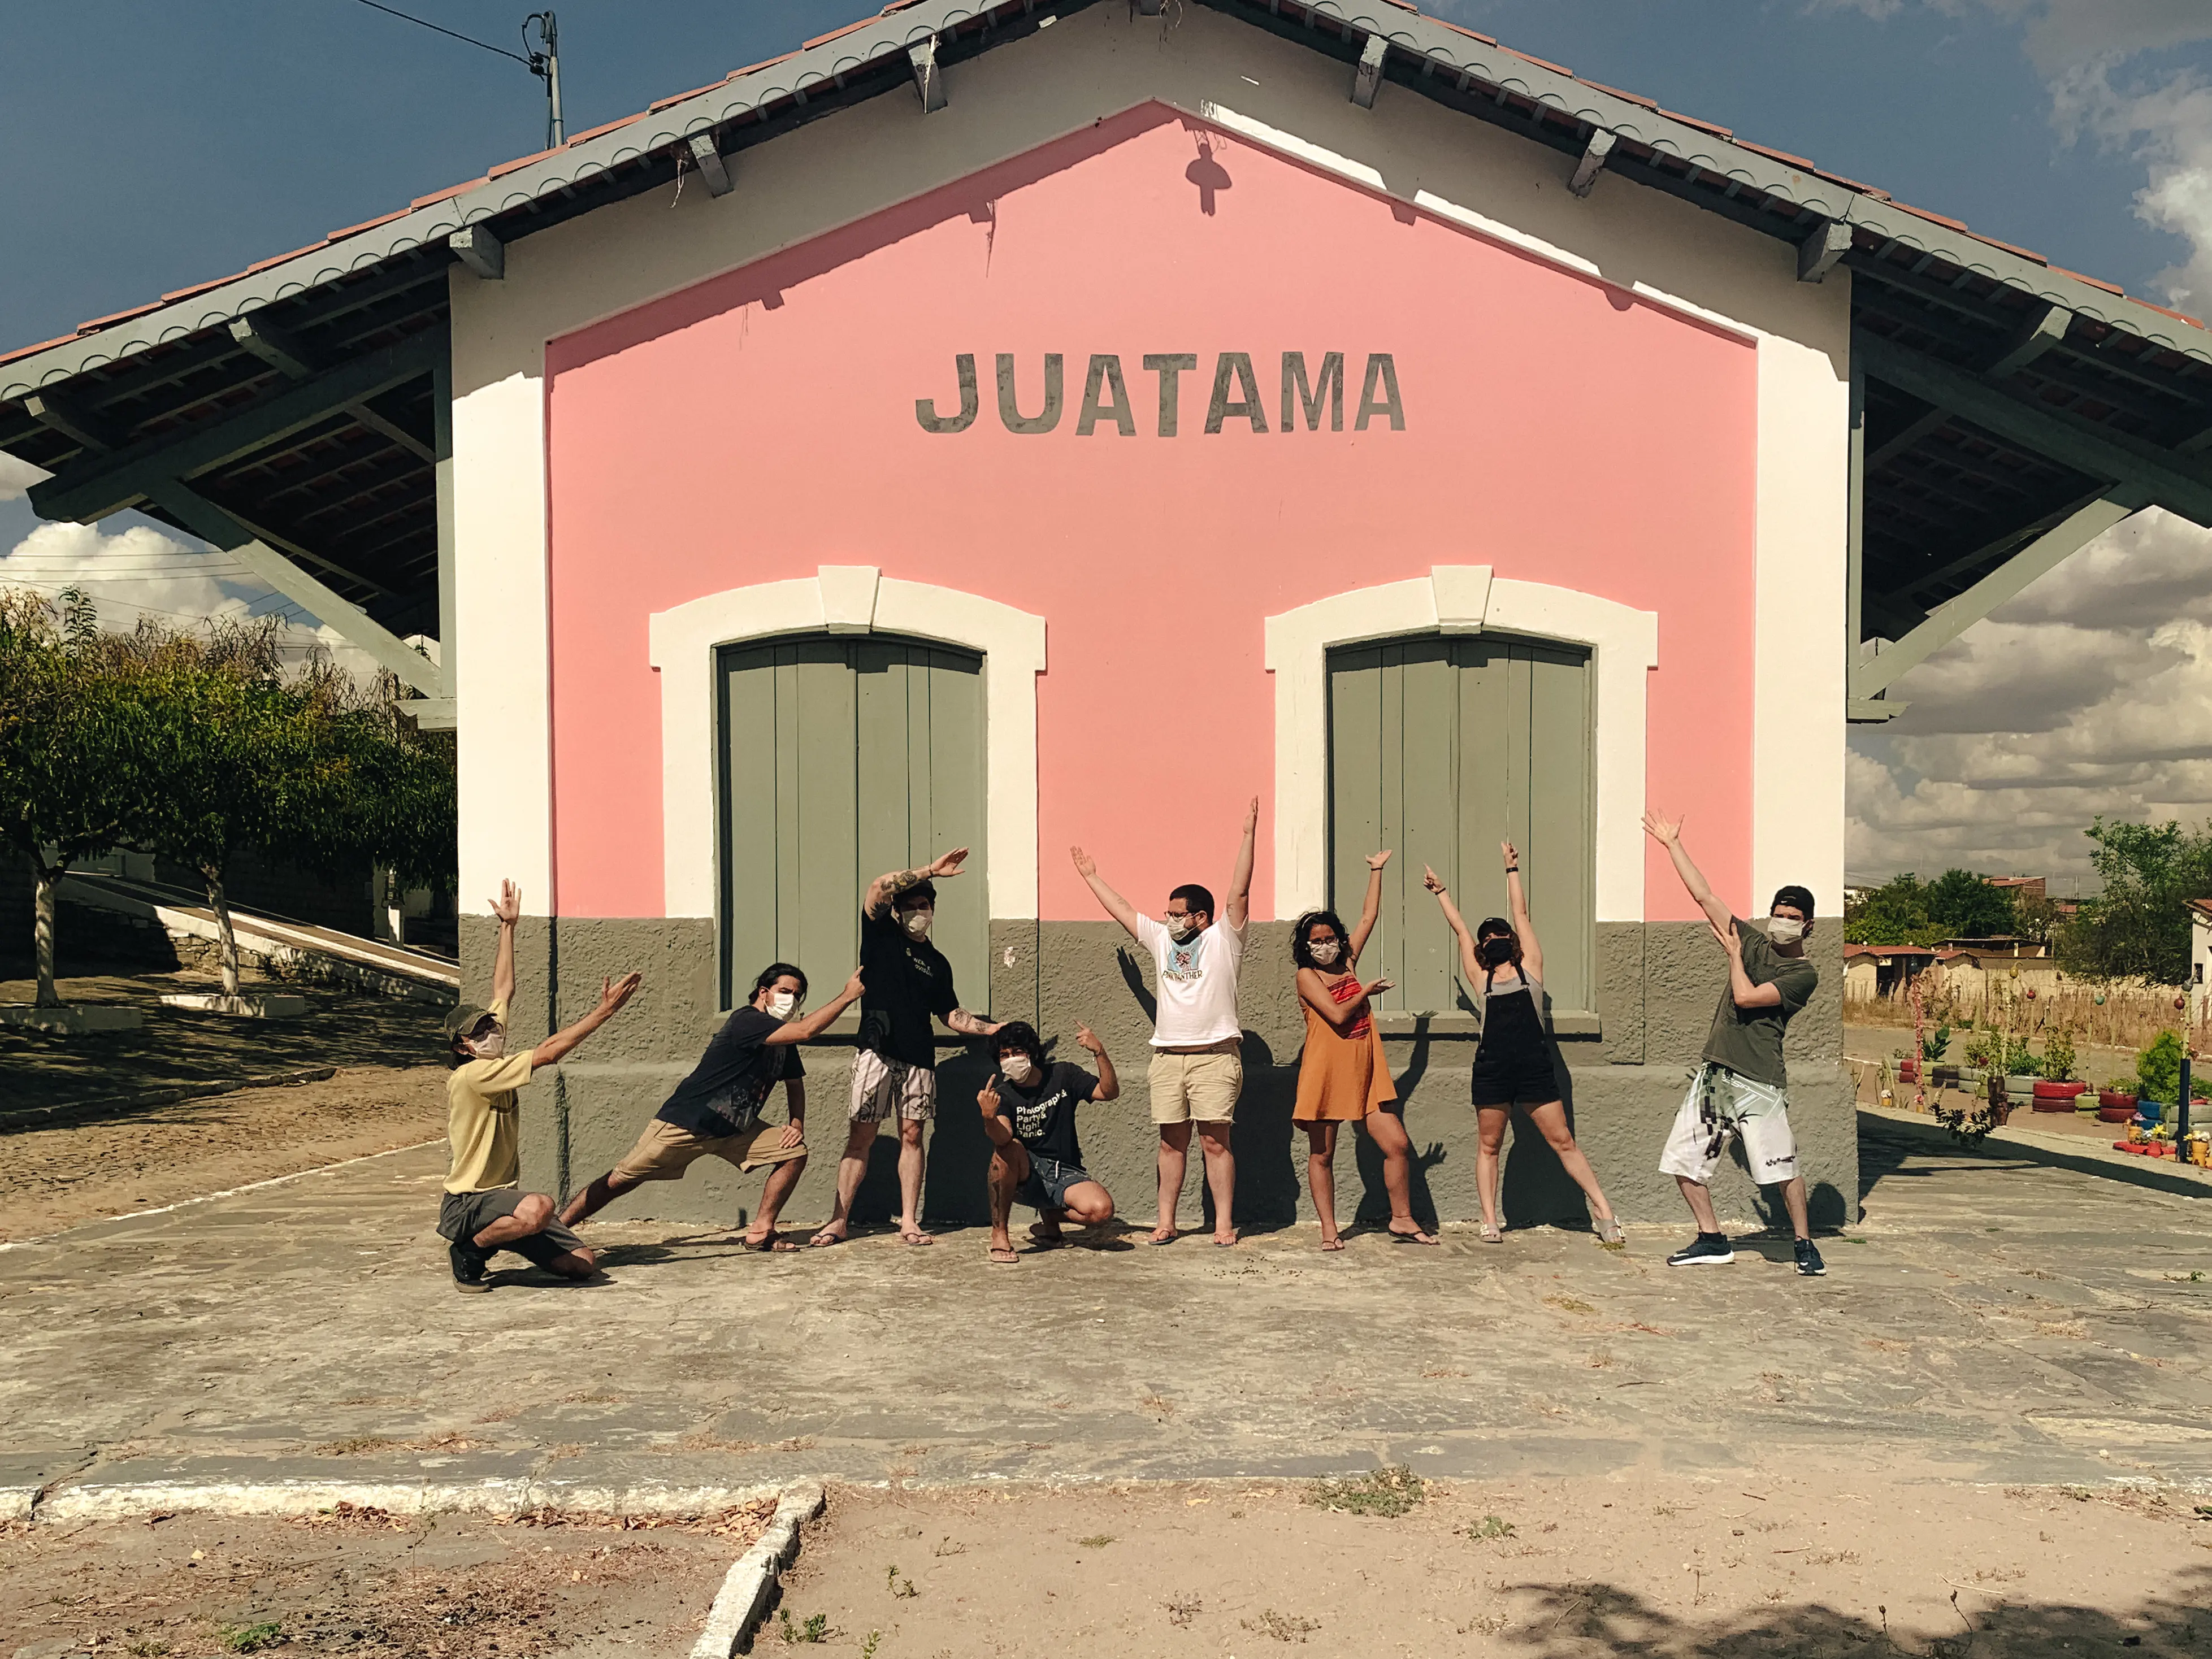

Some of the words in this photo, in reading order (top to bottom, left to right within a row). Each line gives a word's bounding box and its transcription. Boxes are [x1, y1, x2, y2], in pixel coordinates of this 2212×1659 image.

[916, 351, 1406, 437] JUATAMA
[1174, 970, 1203, 981] PANTHER
[1017, 1114, 1040, 1123] Party
[1040, 1111, 1047, 1119] &
[1017, 1121, 1040, 1132] Light
